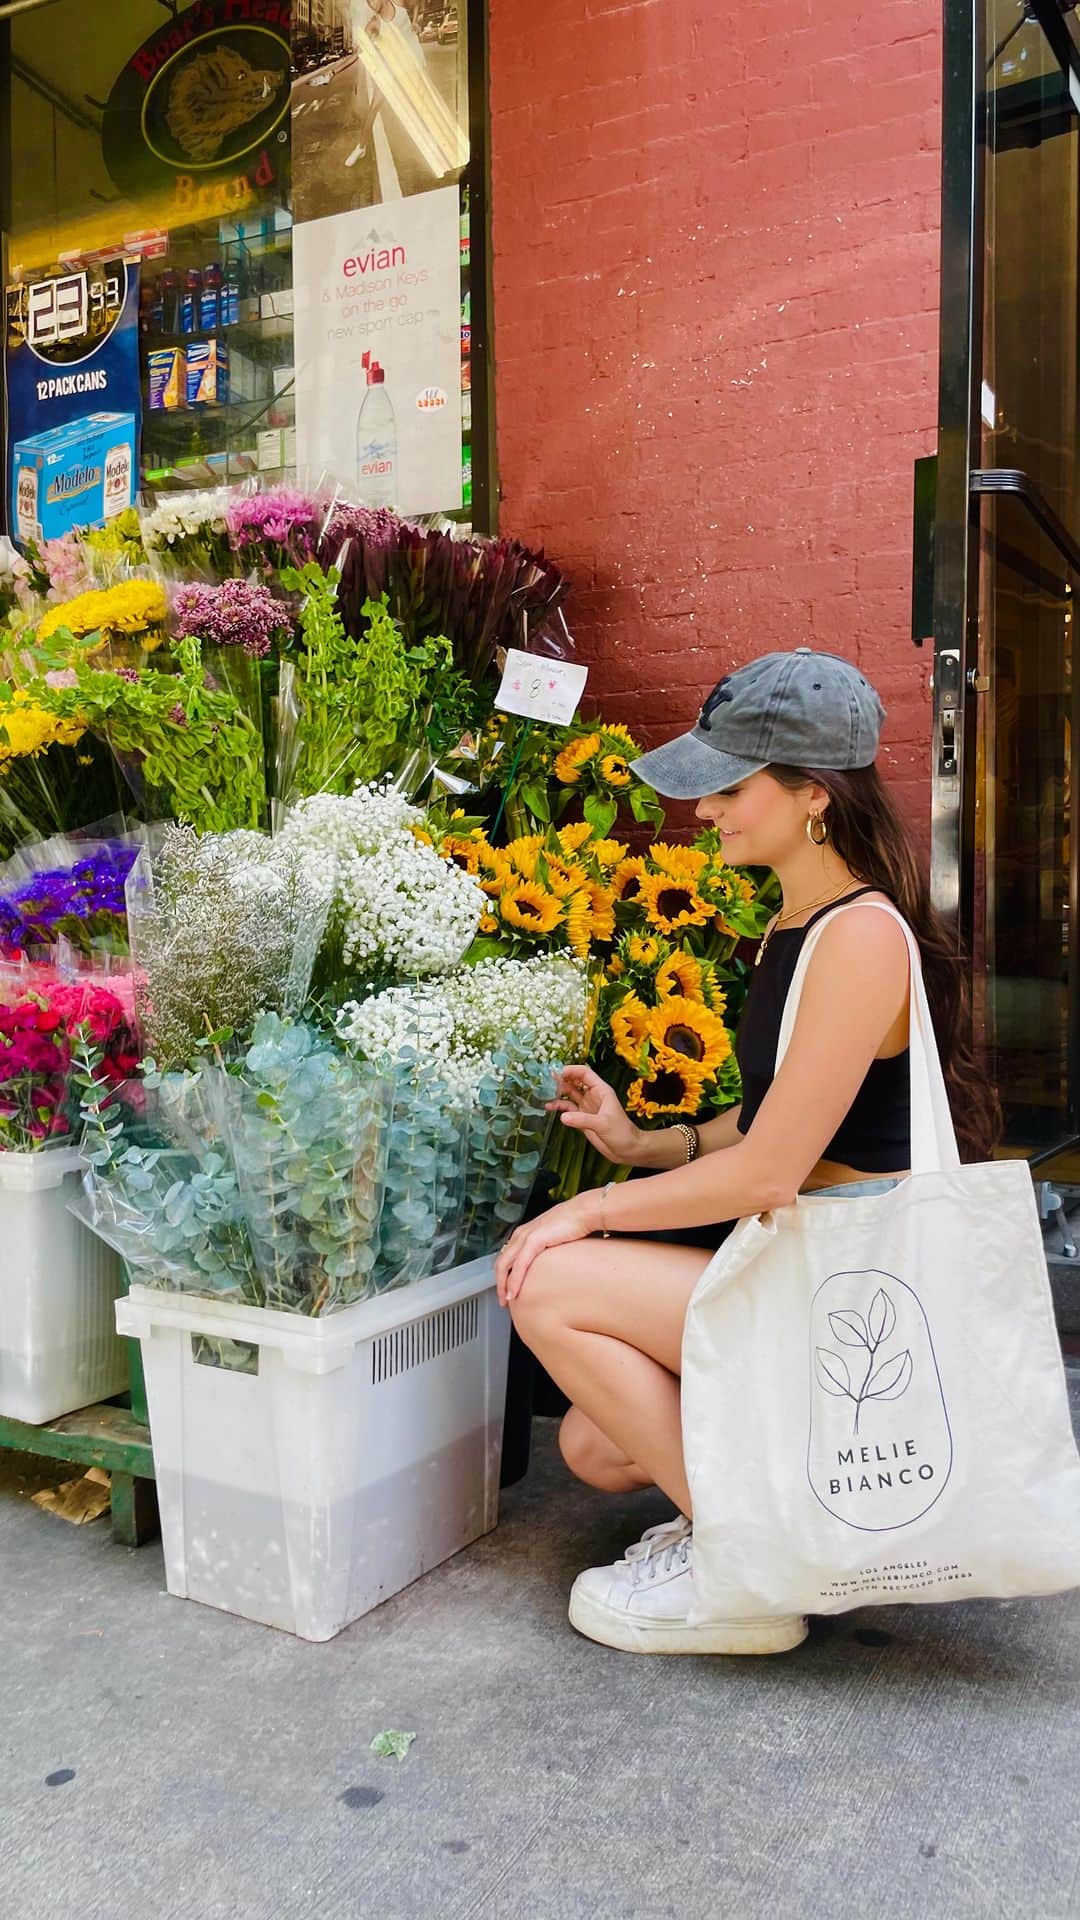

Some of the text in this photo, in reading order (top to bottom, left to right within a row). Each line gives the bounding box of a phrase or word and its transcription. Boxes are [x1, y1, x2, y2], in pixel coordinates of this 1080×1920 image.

[176, 151, 273, 209] Brand
[343, 246, 405, 277] evian
[336, 278, 392, 300] Madison
[397, 269, 430, 288] Keys
[342, 294, 408, 319] on the go
[327, 326, 353, 342] new
[359, 316, 393, 337] sport
[398, 311, 423, 327] cap
[37, 370, 107, 400] 12 PACK CANS
[54, 465, 96, 494] Modelo
[361, 461, 392, 475] evian
[837, 1439, 917, 1465] MELIE
[829, 1464, 934, 1495] BIANCO
[883, 1560, 928, 1571] ANGELES
[852, 1585, 878, 1593] WITH
[882, 1579, 935, 1591] RECYCLED
[938, 1572, 973, 1582] FIBERS
